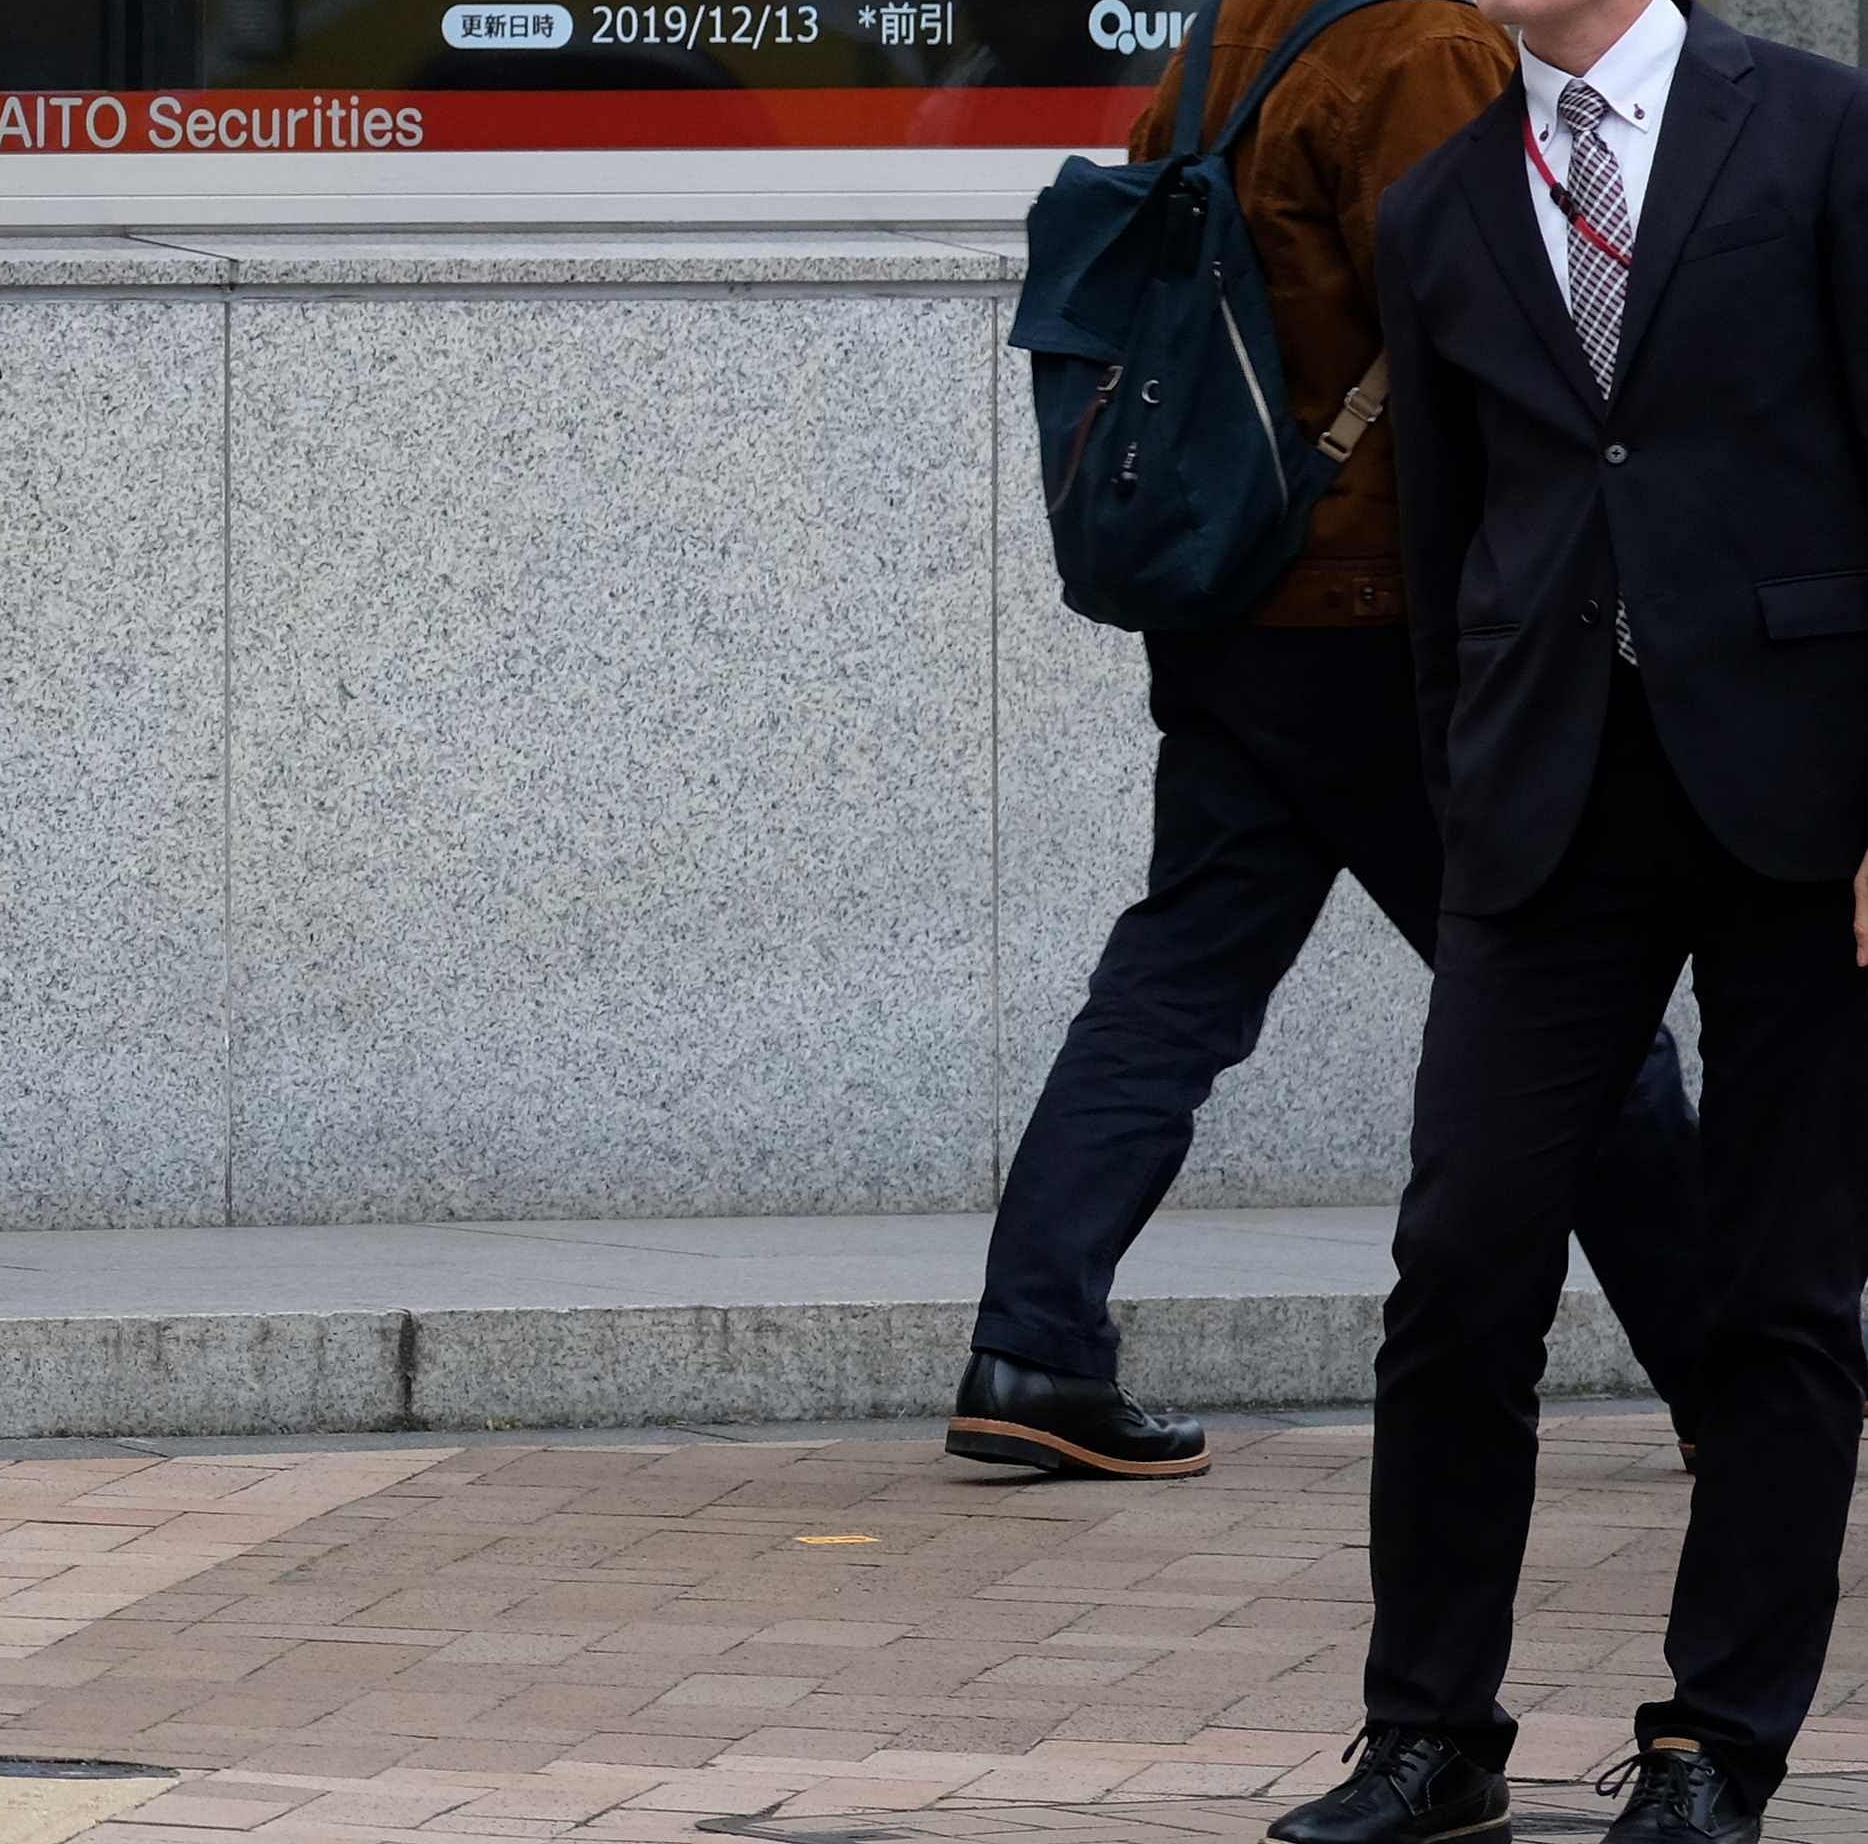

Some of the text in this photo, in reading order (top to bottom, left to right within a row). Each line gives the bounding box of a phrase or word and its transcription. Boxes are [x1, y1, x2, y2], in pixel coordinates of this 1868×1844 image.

[461, 14, 554, 38] 更新日時
[592, 5, 818, 49] 2019/12/13
[149, 96, 422, 148] Securities
